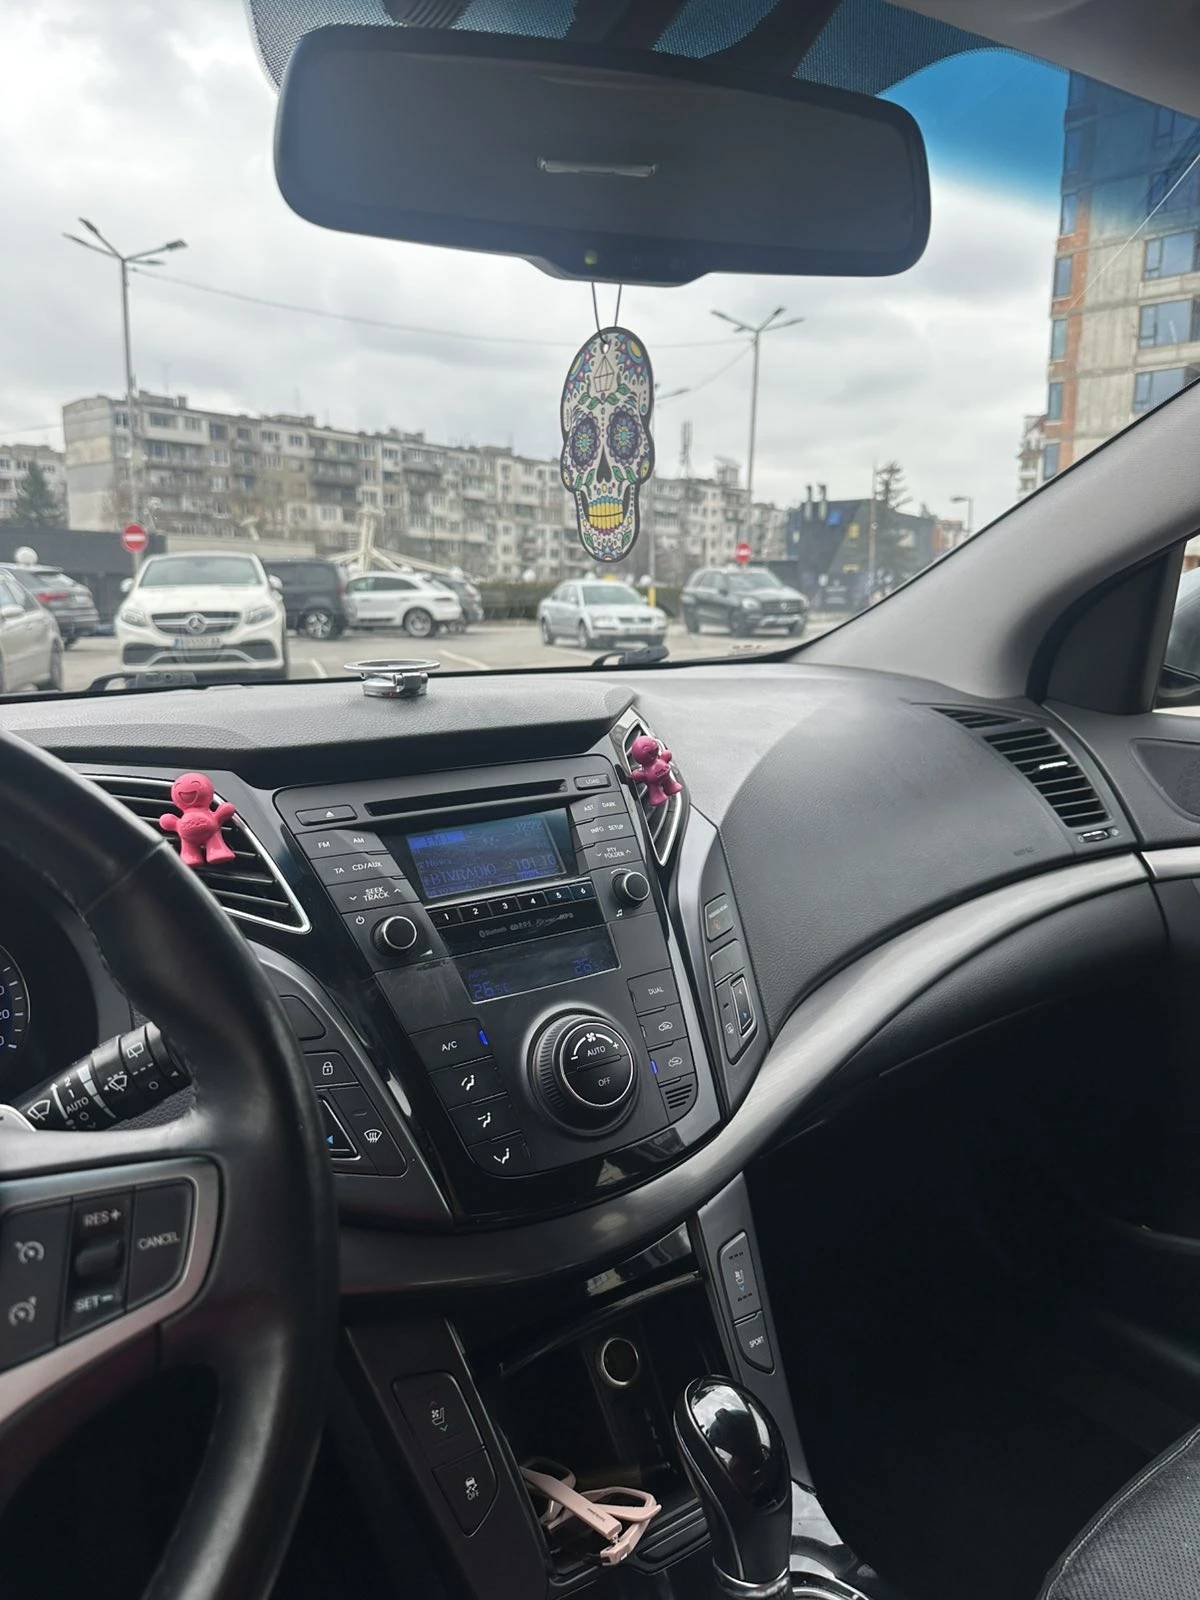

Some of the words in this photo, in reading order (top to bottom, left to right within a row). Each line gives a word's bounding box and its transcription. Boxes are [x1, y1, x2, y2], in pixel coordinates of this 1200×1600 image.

[590, 826, 605, 834] INFO
[318, 841, 331, 849] FM
[333, 867, 345, 875] TA
[352, 861, 383, 871] CD/AUX
[365, 886, 384, 895] SEEK
[363, 892, 389, 901] TRACK
[444, 913, 450, 921] 1
[472, 907, 479, 915] 2
[502, 902, 509, 910] 3
[530, 897, 537, 905] 4
[580, 887, 587, 895] 6
[648, 986, 664, 995] DUAL
[441, 1040, 458, 1051] A/C
[587, 1045, 606, 1057] AUTO
[64, 1077, 71, 1087] 2
[598, 1077, 611, 1087] OFF
[69, 1089, 75, 1098] 1
[66, 1097, 89, 1114] AUTO
[138, 1231, 180, 1250] CANCEL
[749, 1335, 764, 1348] SPORT
